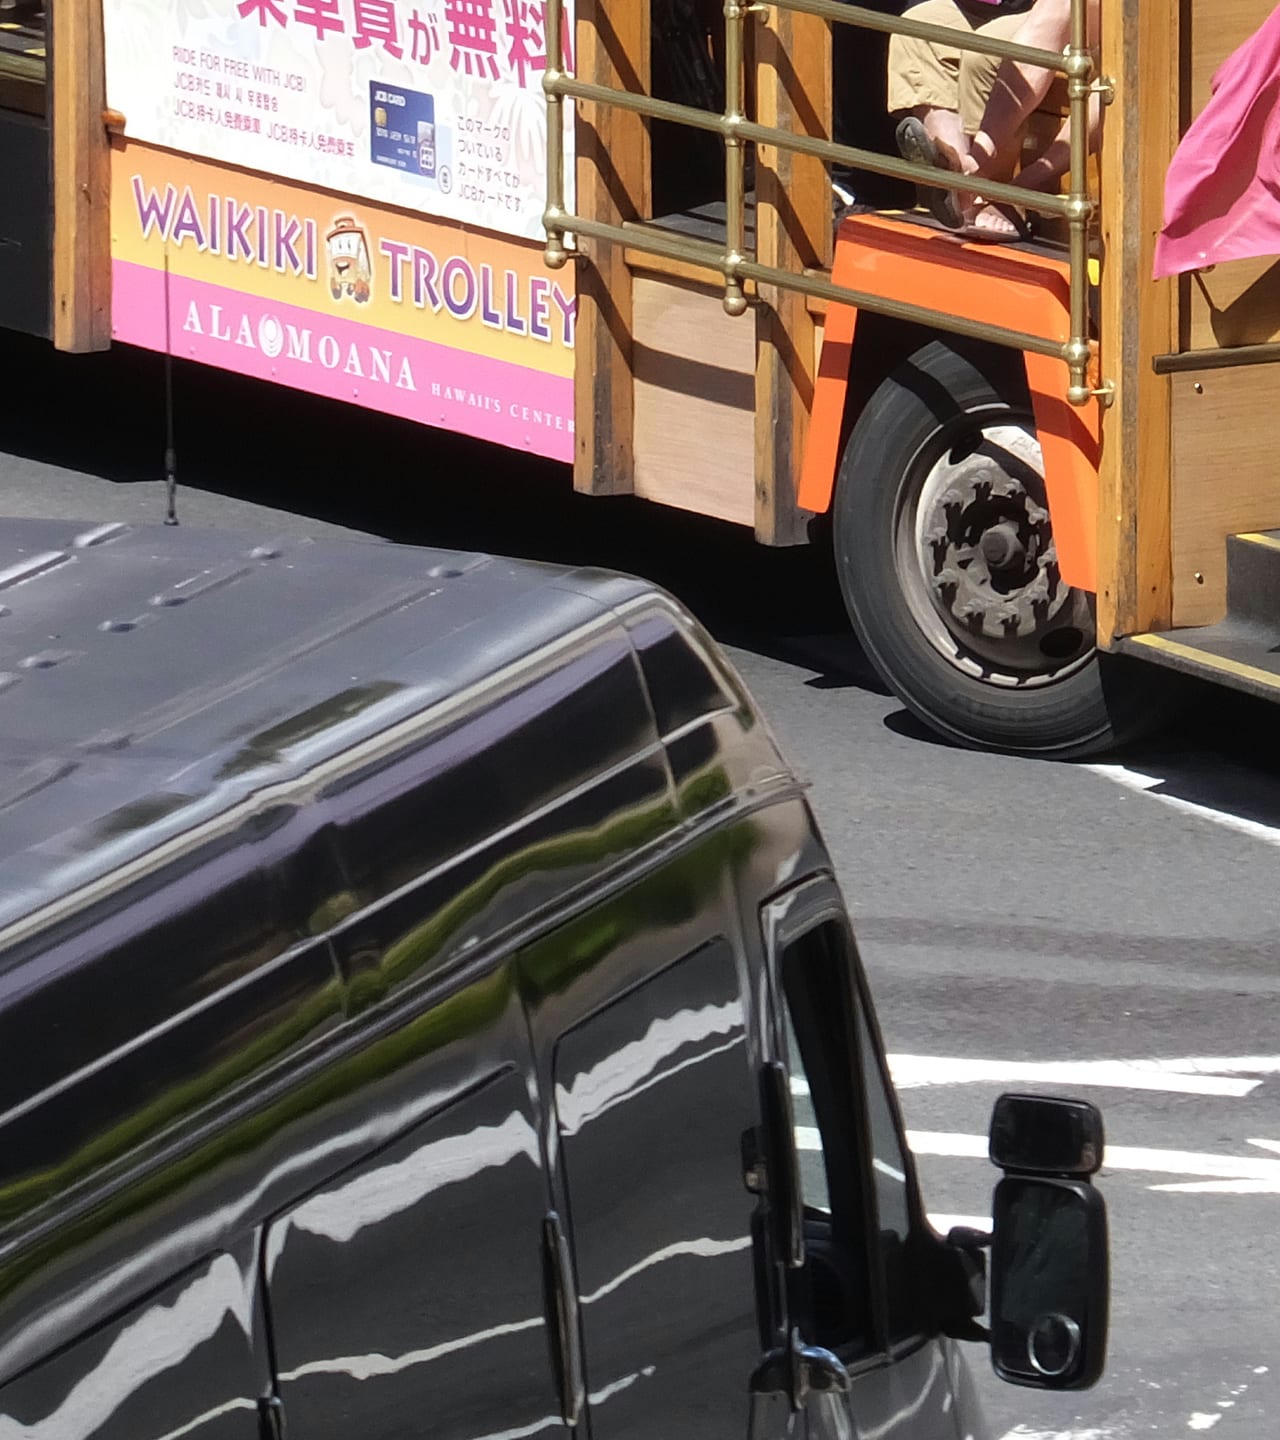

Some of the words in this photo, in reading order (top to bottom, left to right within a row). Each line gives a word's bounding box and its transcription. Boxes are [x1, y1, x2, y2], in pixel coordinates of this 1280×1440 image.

[172, 45, 196, 67] RIDE
[199, 52, 221, 72] FOR
[223, 57, 250, 80] FREE
[252, 65, 281, 87] WITH
[130, 173, 318, 282] WAIKIKI
[379, 236, 577, 349] TROLLEY
[285, 324, 418, 392] MOANA
